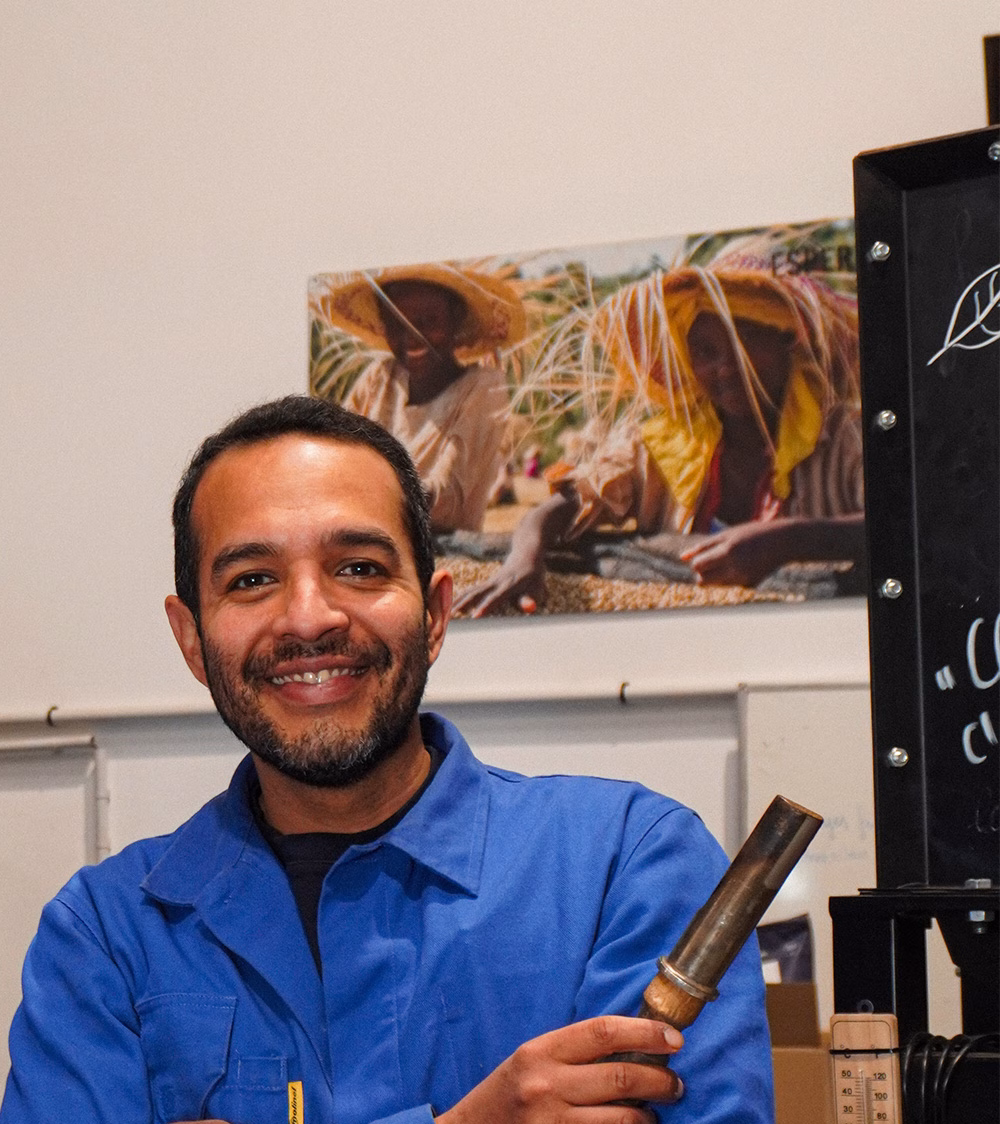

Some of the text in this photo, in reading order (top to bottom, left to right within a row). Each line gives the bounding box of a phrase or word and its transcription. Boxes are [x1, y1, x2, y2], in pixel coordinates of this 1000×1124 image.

[873, 1072, 887, 1080] 120
[874, 1092, 888, 1100] 100
[843, 1105, 853, 1113] 30
[876, 1112, 887, 1120] 80
